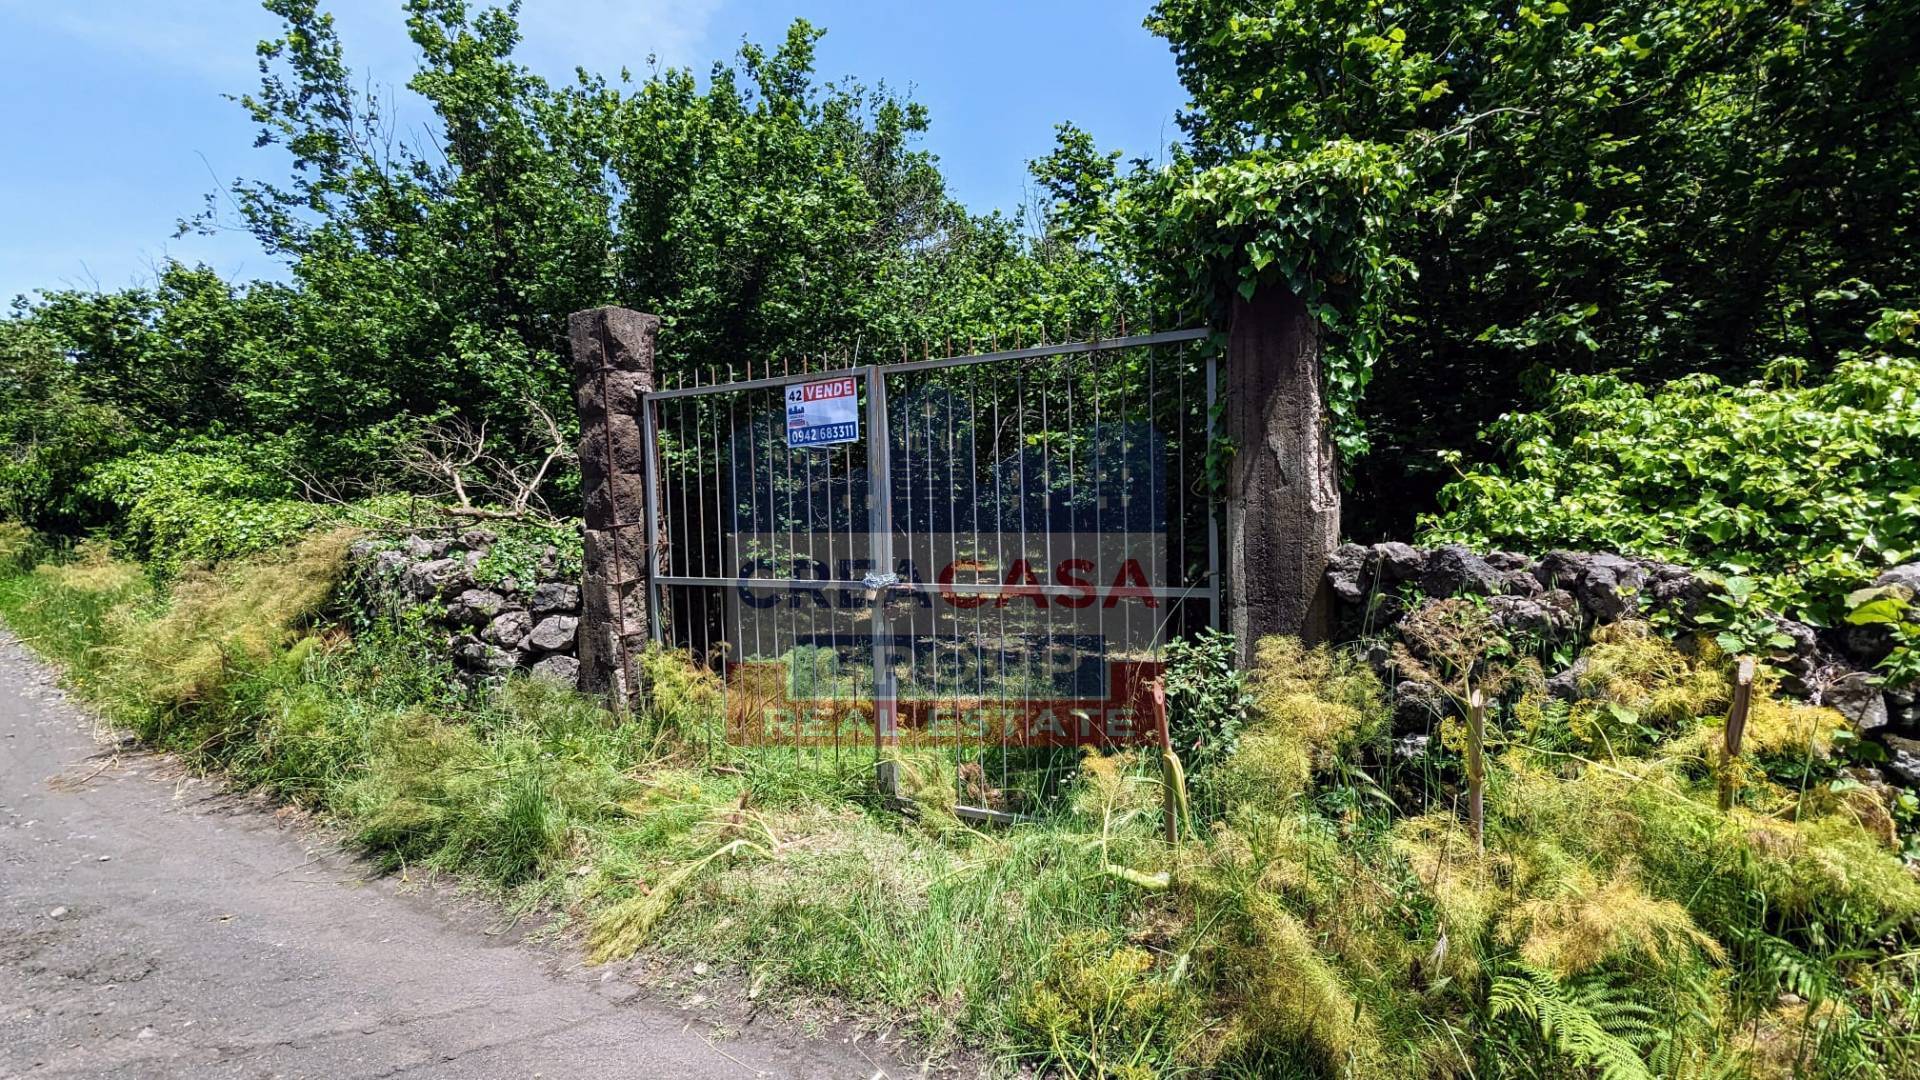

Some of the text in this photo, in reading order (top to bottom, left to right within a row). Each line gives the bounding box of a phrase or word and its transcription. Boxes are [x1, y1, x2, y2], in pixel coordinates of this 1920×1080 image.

[788, 380, 852, 402] 42 VENDE
[791, 424, 854, 443] 0942 683311
